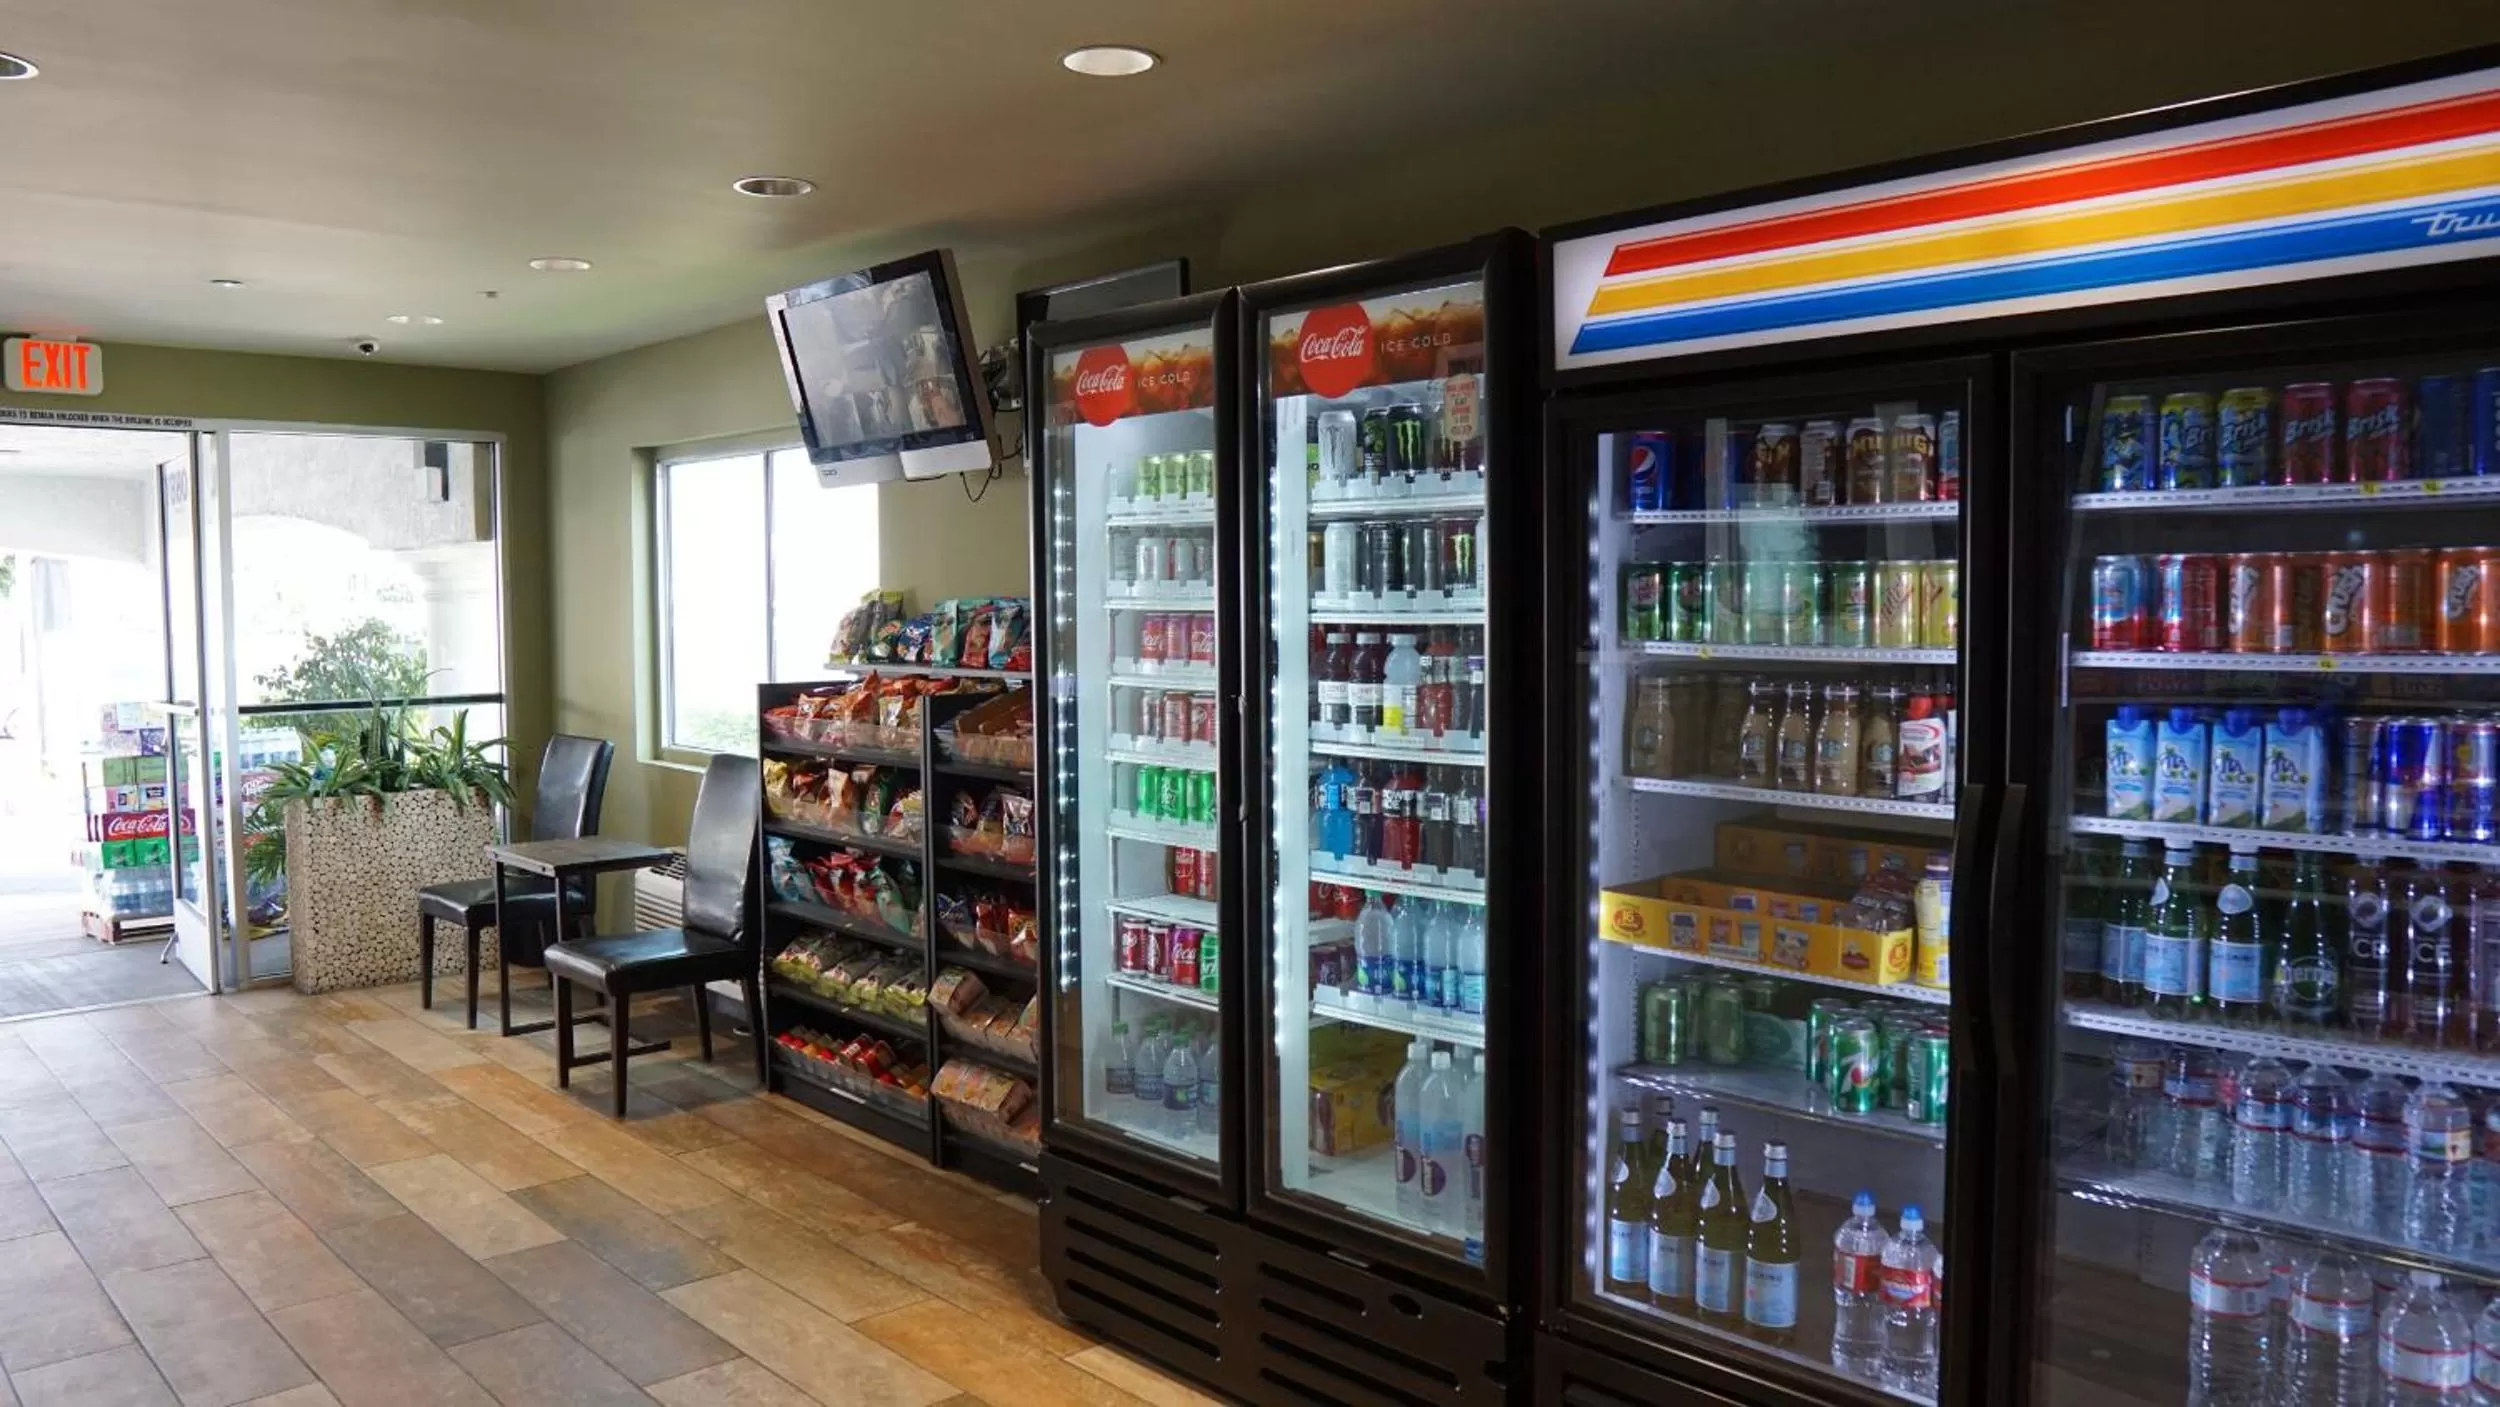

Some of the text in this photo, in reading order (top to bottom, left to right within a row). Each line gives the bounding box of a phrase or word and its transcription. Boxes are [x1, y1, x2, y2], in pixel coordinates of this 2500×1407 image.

[2410, 211, 2500, 237] tru
[1300, 325, 1368, 363] Coca-Cola
[1380, 332, 1452, 354] ICE COLD
[22, 340, 92, 390] EXIT
[1076, 364, 1127, 397] Coca-Cola
[1137, 370, 1191, 388] ICE COLD
[2285, 406, 2335, 446] Brisk
[2347, 404, 2399, 441] Brisk
[108, 813, 168, 837] Coca-Cola
